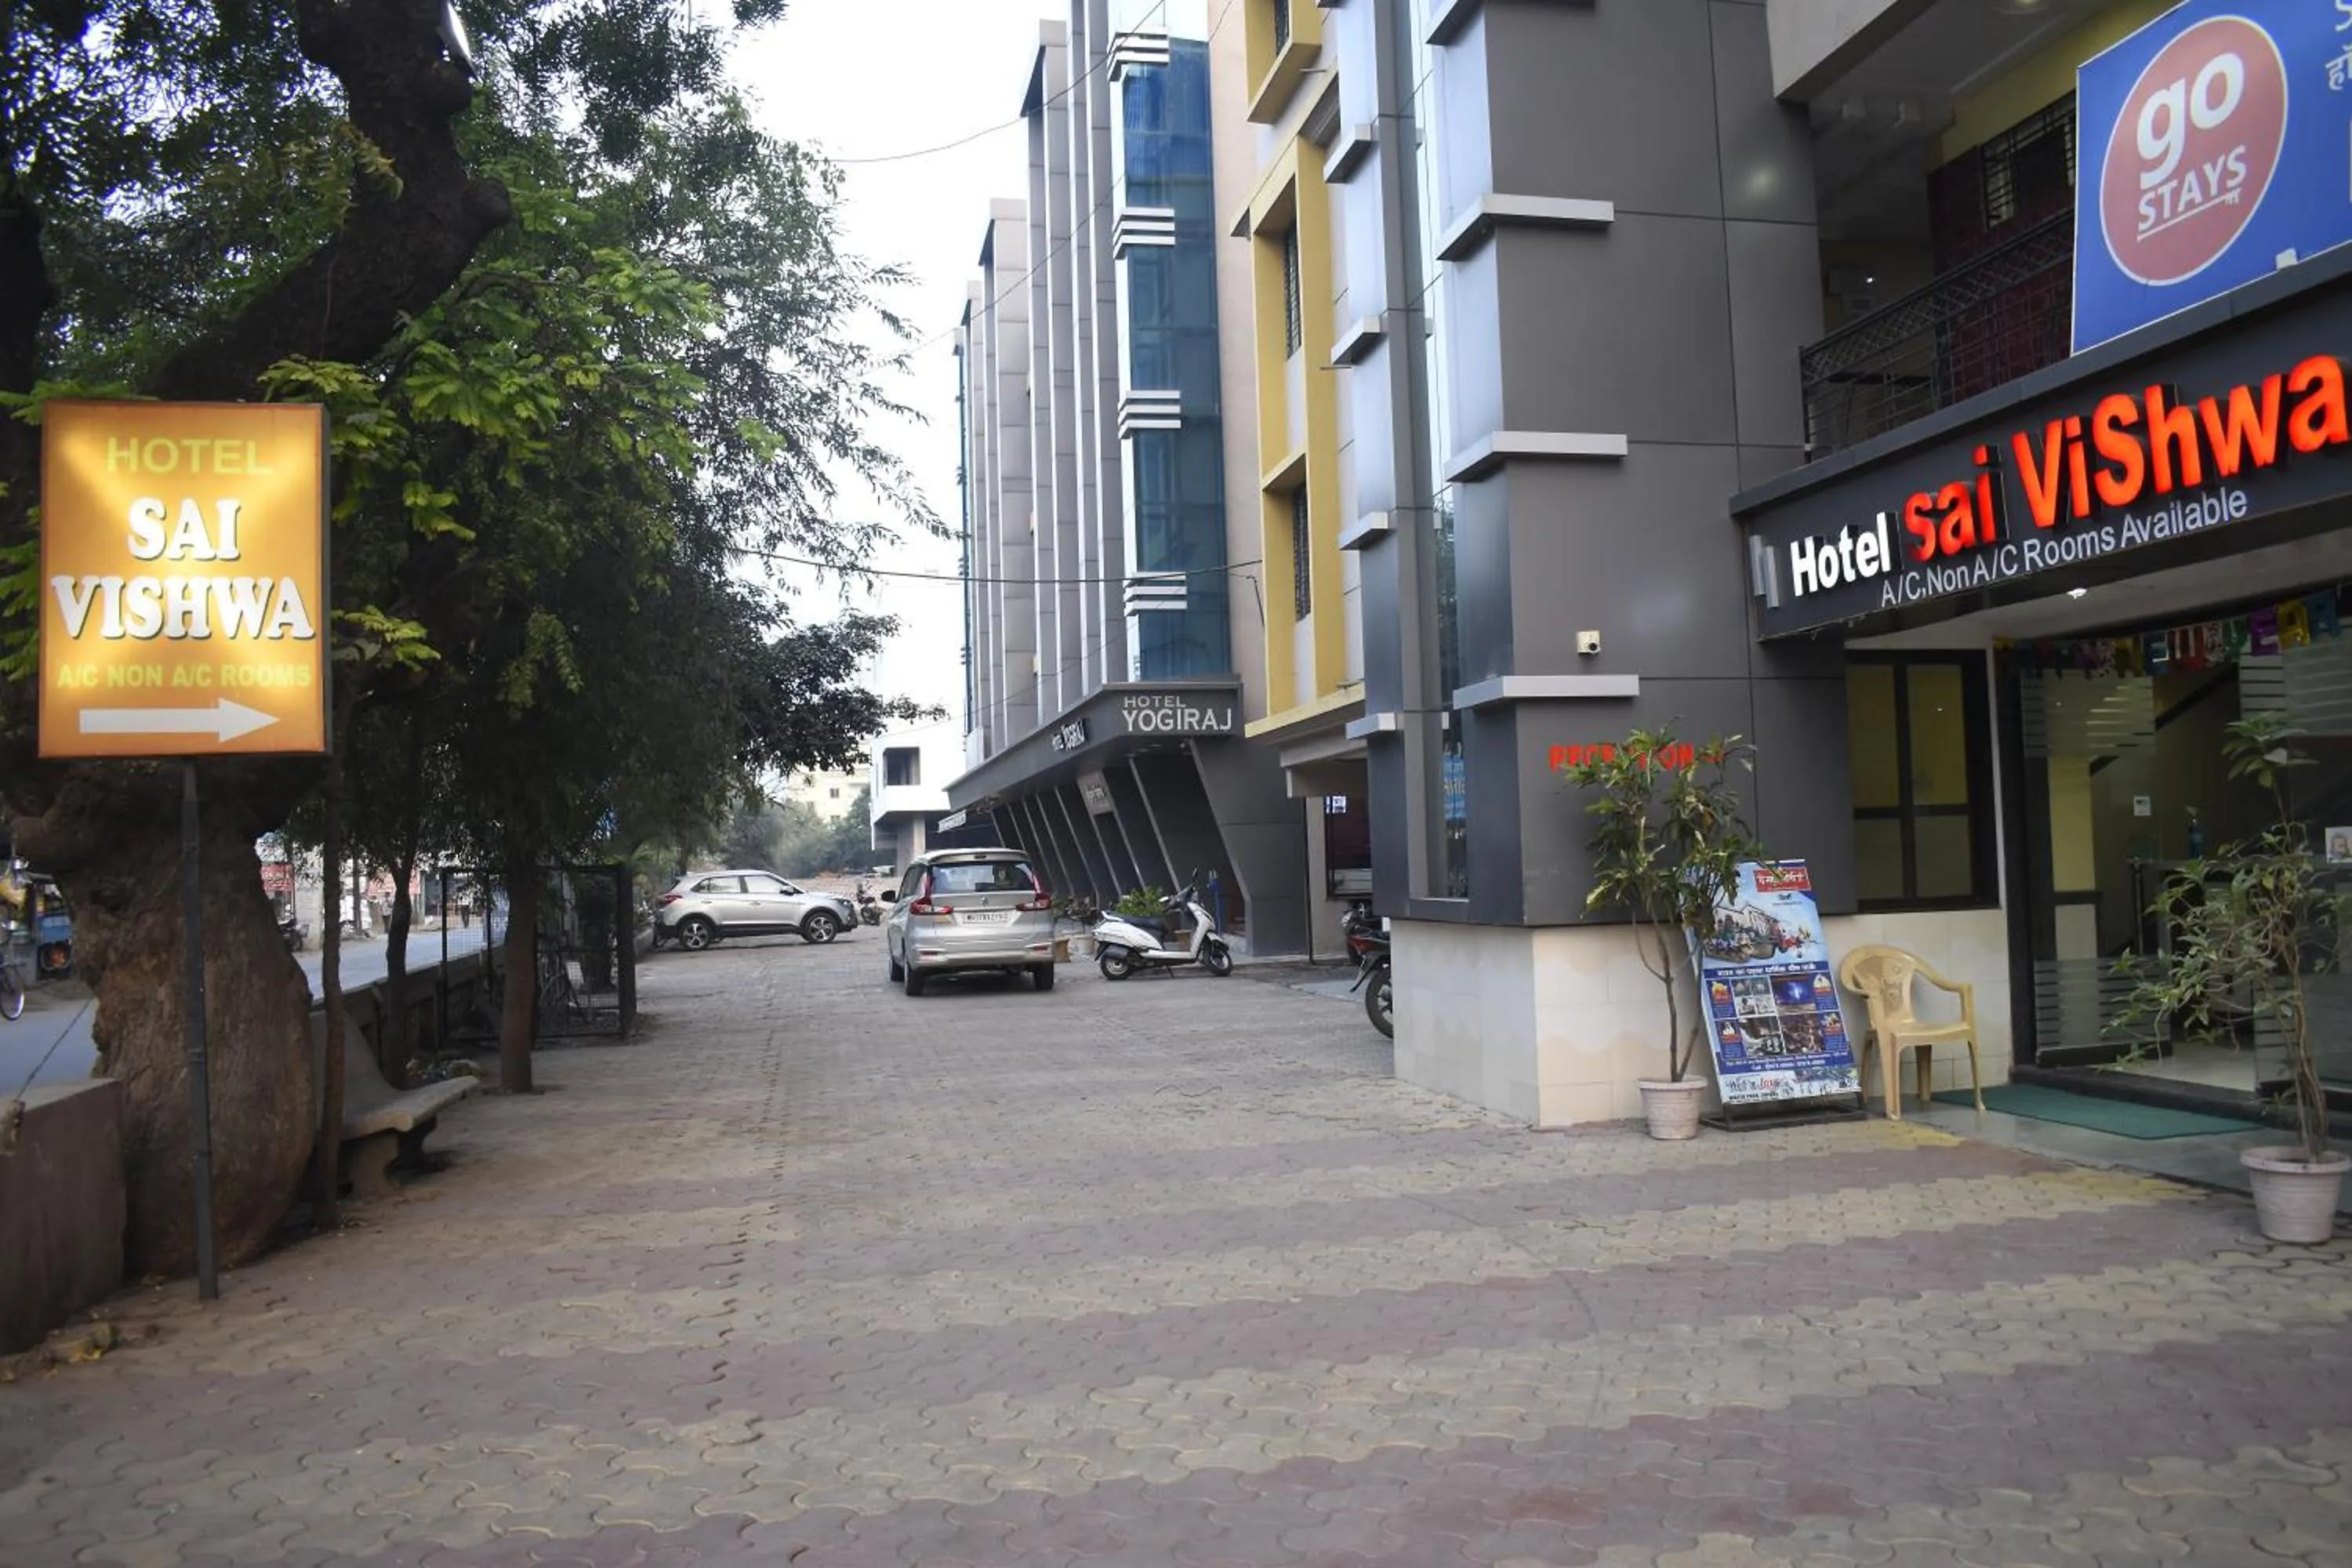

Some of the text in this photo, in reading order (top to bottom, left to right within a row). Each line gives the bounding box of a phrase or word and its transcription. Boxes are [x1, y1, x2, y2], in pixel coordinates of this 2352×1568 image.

[2137, 53, 2244, 191] go
[2138, 145, 2247, 233] STAYS
[106, 436, 274, 474] HOTEL
[127, 496, 242, 561] SAI
[1790, 511, 1892, 597] Hotel
[1973, 543, 2019, 586] A/C
[2023, 524, 2117, 572] Rooms
[2120, 486, 2249, 548] Available
[51, 575, 316, 641] VISHWA
[57, 663, 311, 688] A/C NON A/C ROOMS
[1123, 695, 1187, 708] HOTEL
[1122, 708, 1232, 731] YOGIRAJ
